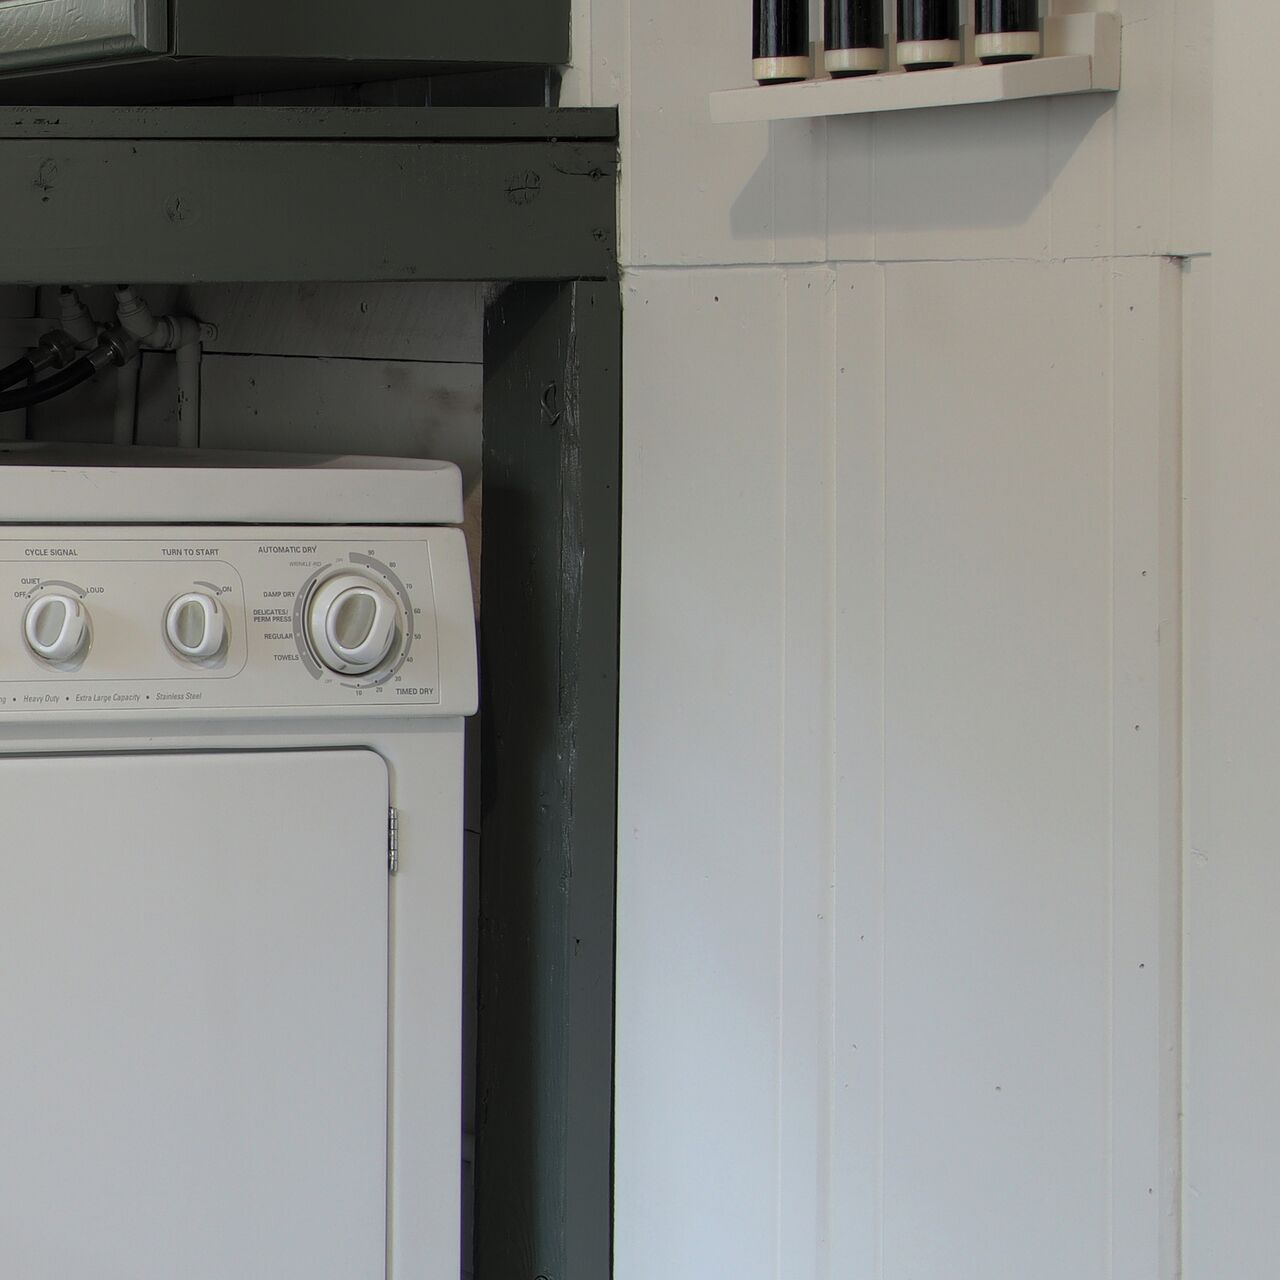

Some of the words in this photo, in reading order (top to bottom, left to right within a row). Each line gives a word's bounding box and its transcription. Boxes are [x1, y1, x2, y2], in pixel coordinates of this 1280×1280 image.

[24, 695, 43, 704] Heavy
[45, 695, 60, 704] Duty
[93, 694, 111, 702] Large
[112, 693, 140, 702] Capacity
[156, 692, 184, 700] Stainless
[185, 692, 202, 700] Steel
